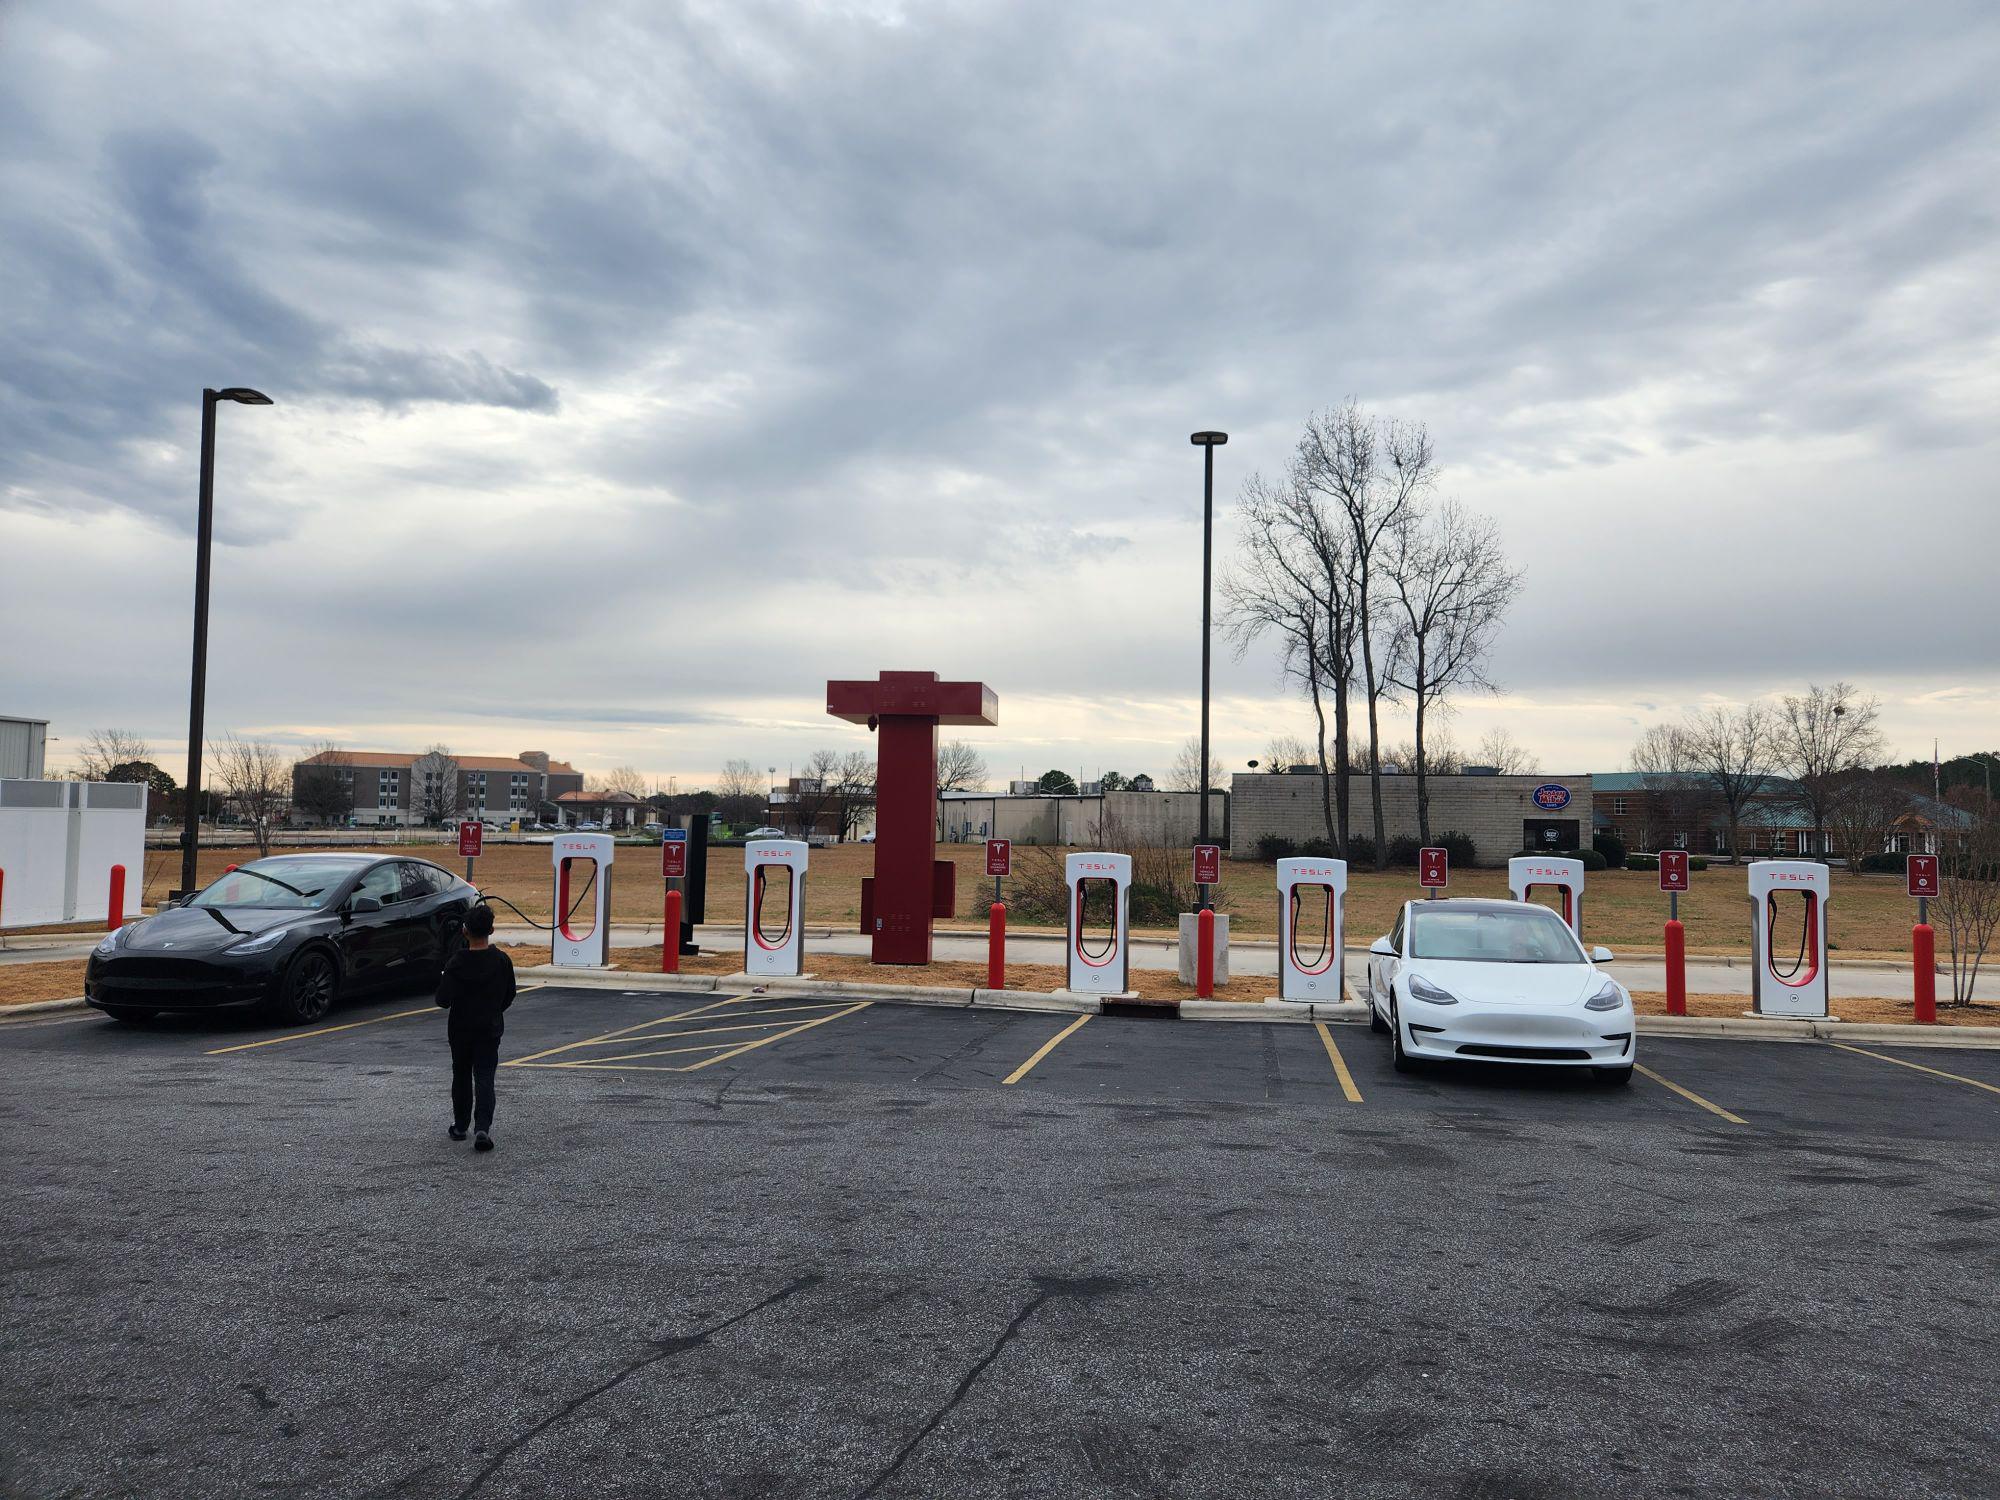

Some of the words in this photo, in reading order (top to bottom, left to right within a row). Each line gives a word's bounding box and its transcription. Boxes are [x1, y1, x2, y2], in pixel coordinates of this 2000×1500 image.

[1292, 868, 1332, 876] TESLA
[1527, 868, 1569, 876] TESLA
[1769, 873, 1814, 881] TESLA
